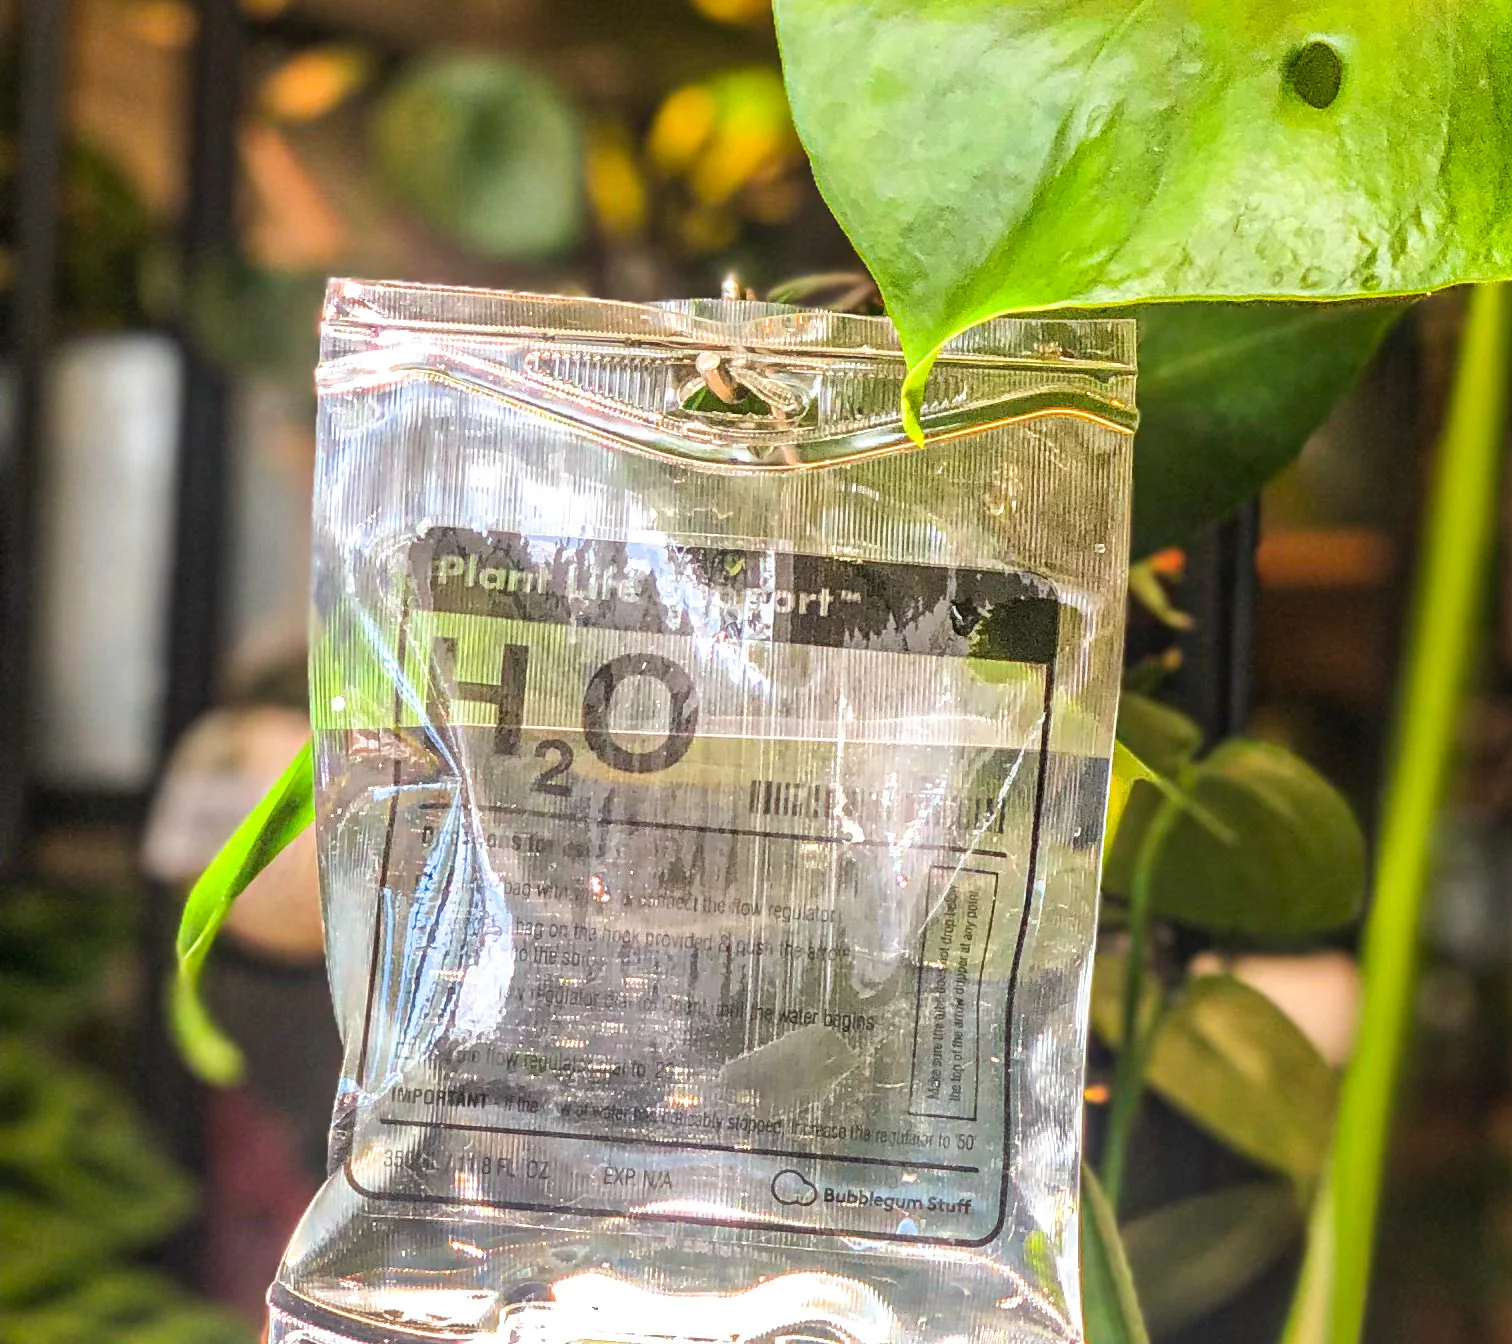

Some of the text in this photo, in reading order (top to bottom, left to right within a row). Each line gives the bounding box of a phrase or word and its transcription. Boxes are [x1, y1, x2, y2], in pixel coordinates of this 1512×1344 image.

[437, 553, 553, 595] Plant
[823, 1187, 972, 1214] Bubblegum Stuff
